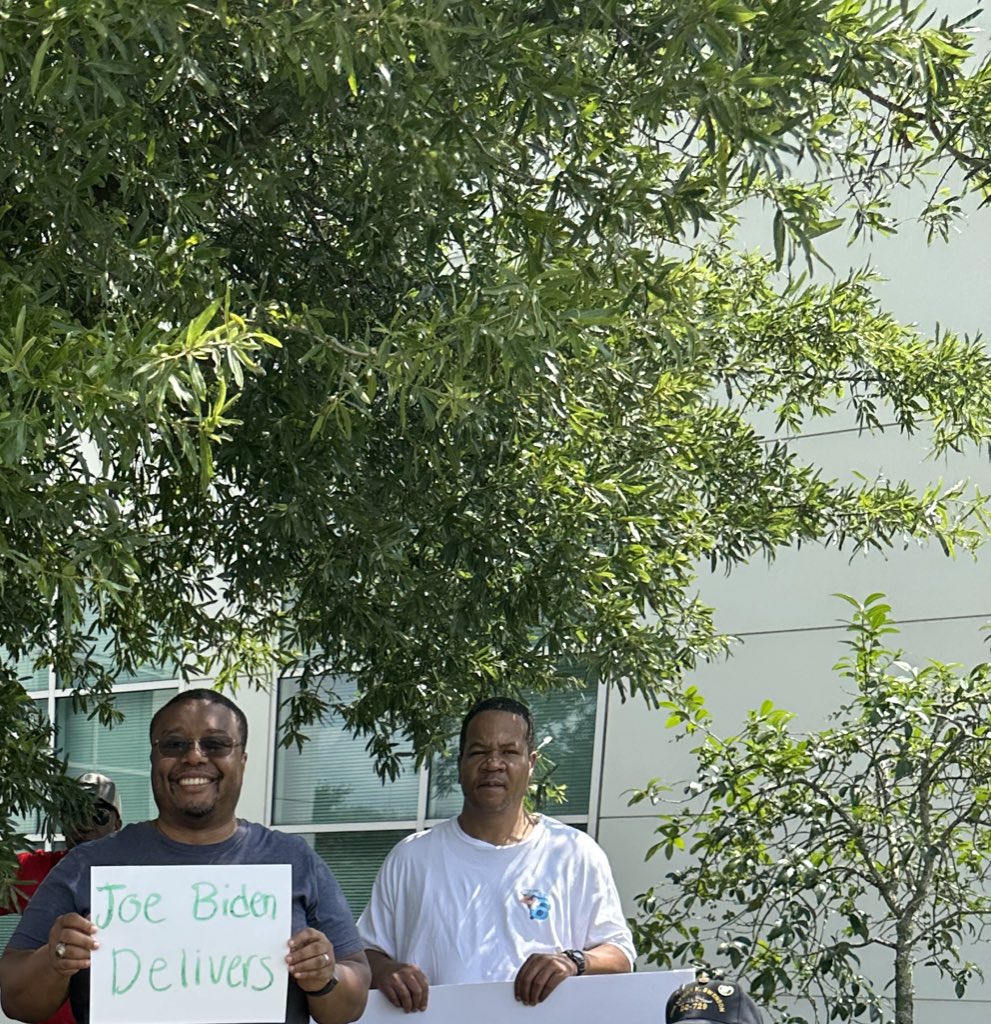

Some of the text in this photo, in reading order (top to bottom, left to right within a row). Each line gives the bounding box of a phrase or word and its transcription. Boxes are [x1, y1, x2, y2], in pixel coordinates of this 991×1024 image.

[96, 881, 277, 930] Joe Biden
[112, 948, 274, 996] Delivers
